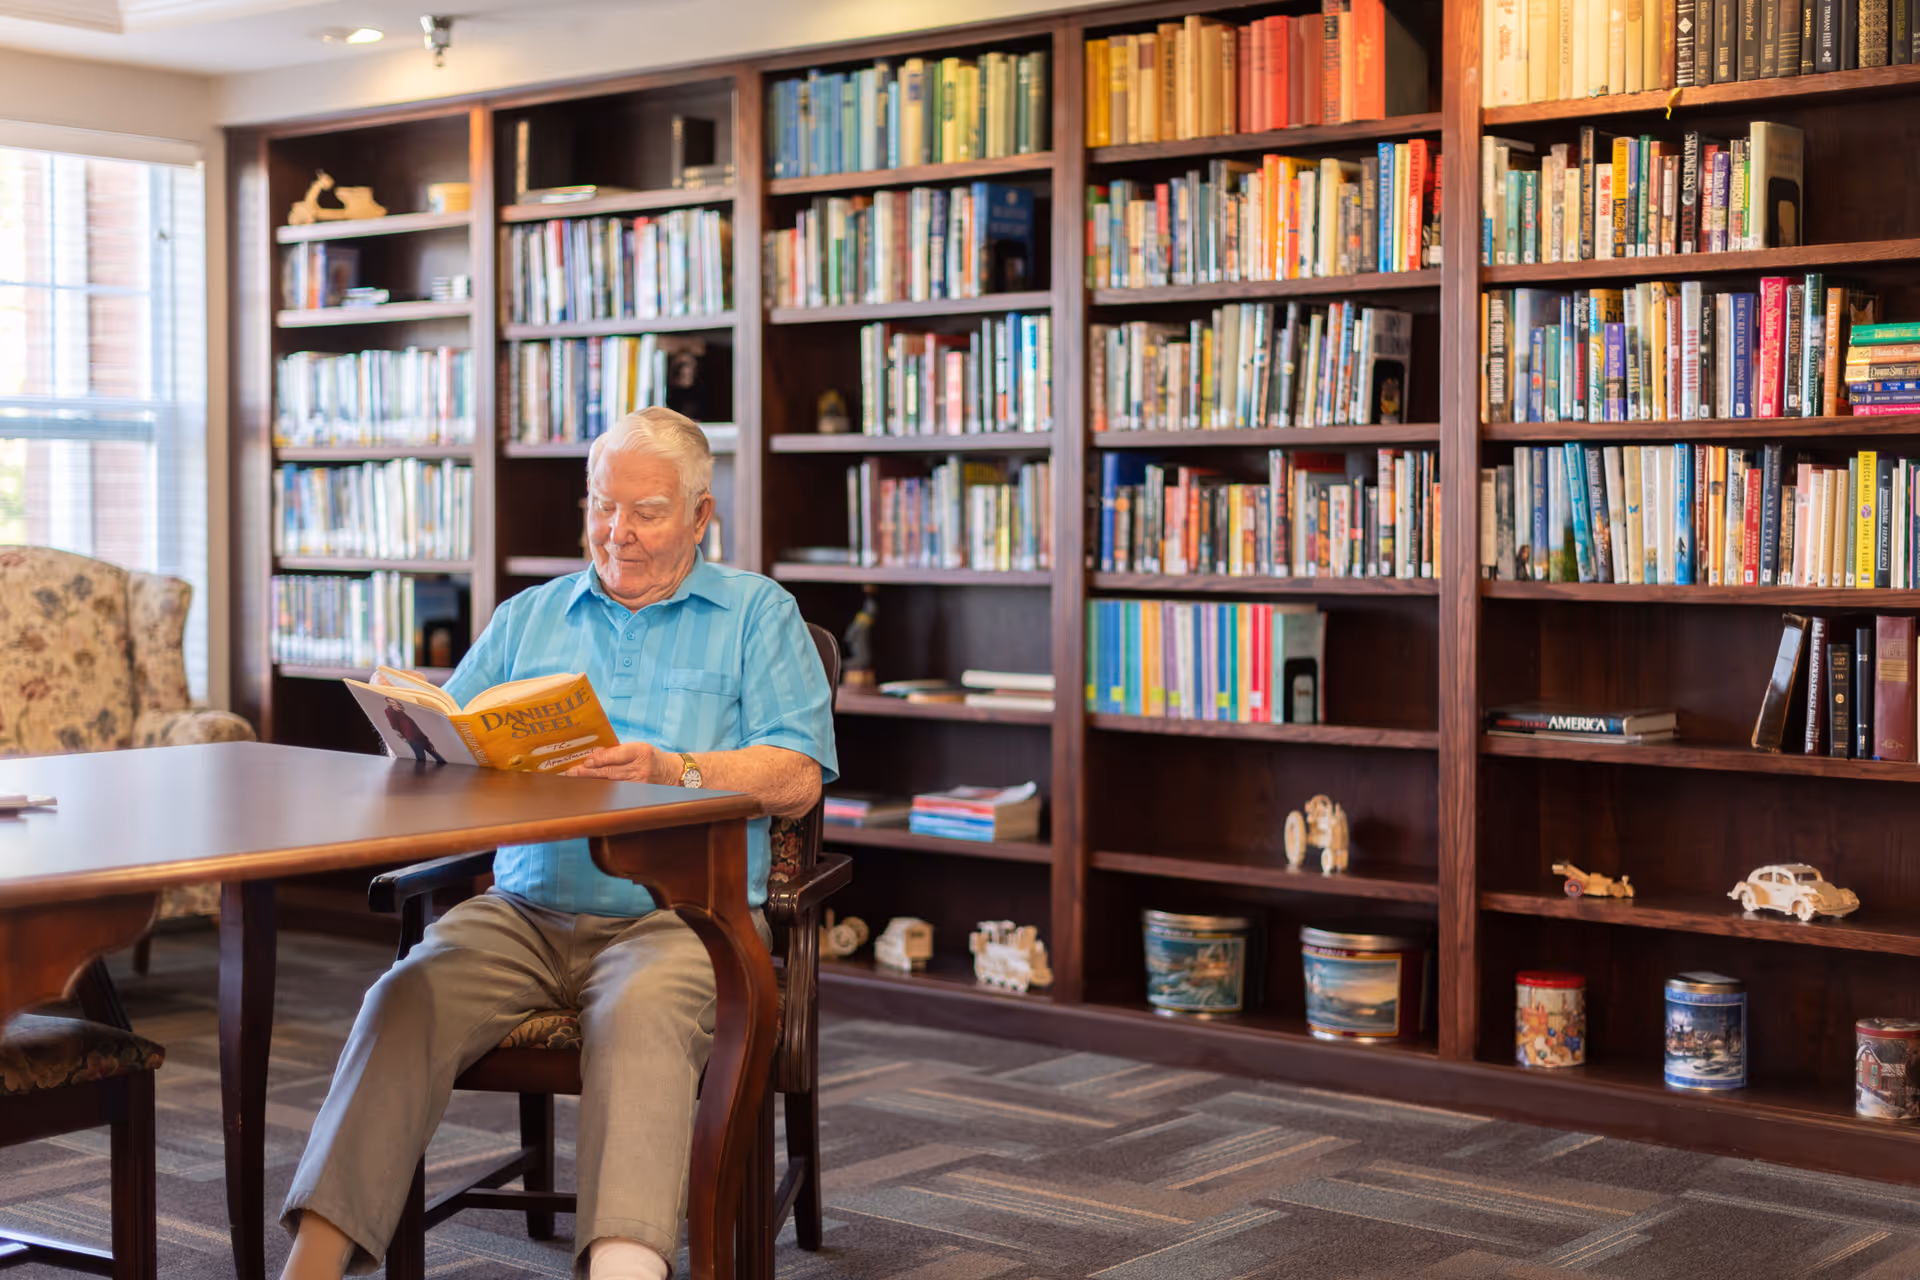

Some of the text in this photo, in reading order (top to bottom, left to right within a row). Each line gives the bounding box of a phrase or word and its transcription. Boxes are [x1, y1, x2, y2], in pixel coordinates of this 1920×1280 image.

[1789, 288, 1801, 316] SIDNEY
[1789, 318, 1800, 355] SHELDON
[1828, 303, 1837, 341] DEWEY
[1766, 494, 1774, 523] ANNE
[1764, 528, 1773, 562] TYLER
[480, 686, 590, 732] DANIELLE
[1548, 715, 1607, 732] AMERICA
[511, 714, 575, 739] STEEL
